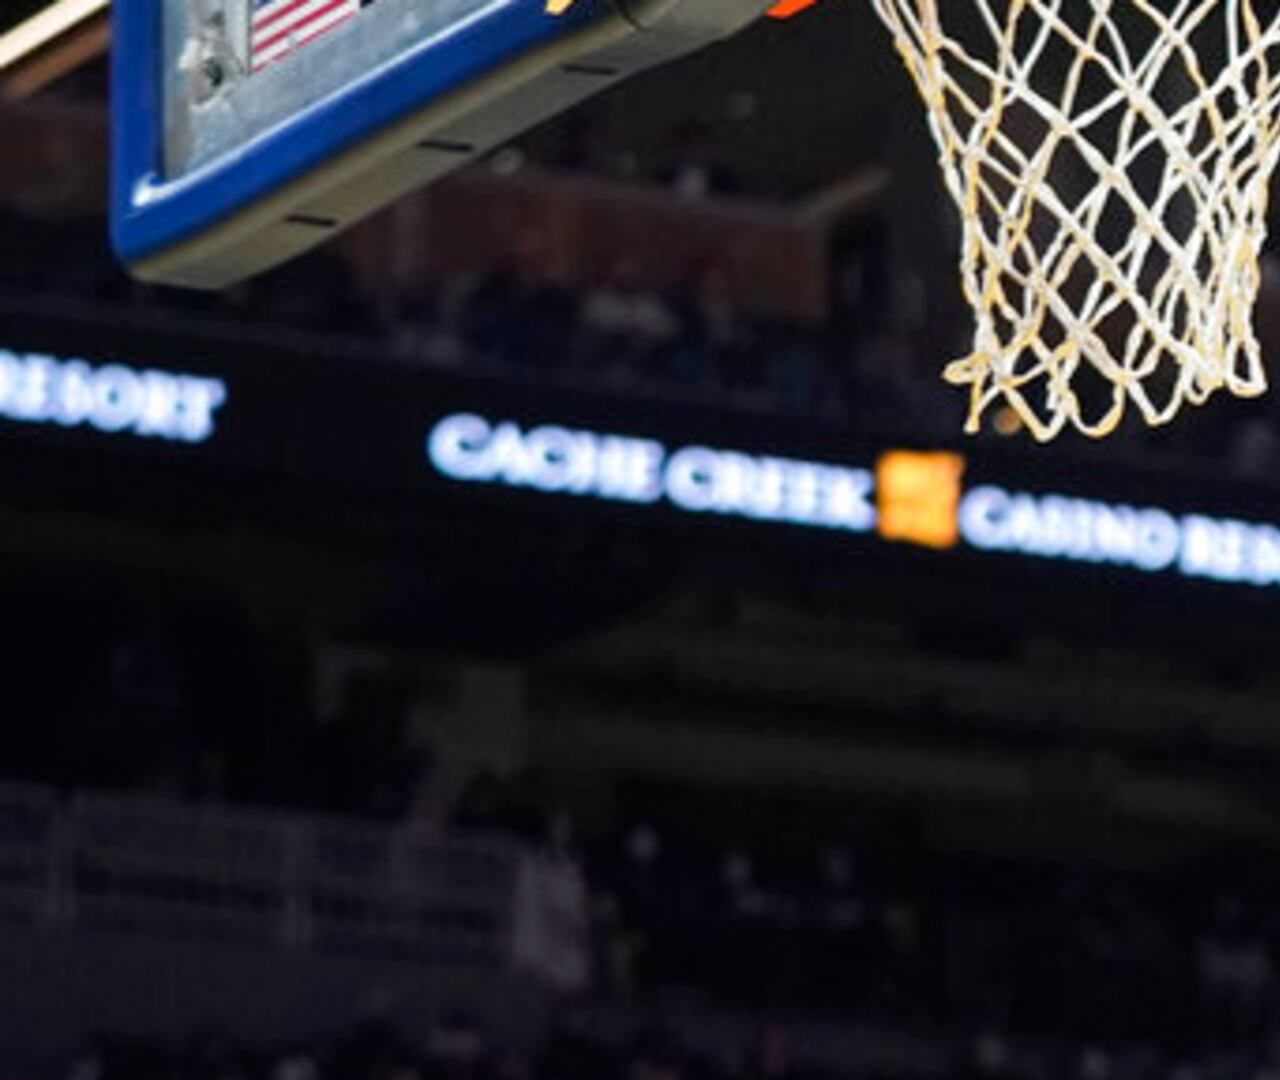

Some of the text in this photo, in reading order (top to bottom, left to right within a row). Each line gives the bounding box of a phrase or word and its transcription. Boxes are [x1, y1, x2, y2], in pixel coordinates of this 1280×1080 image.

[428, 413, 664, 503] CACHE
[664, 446, 874, 531] CREEK
[958, 485, 1179, 571] CASINO
